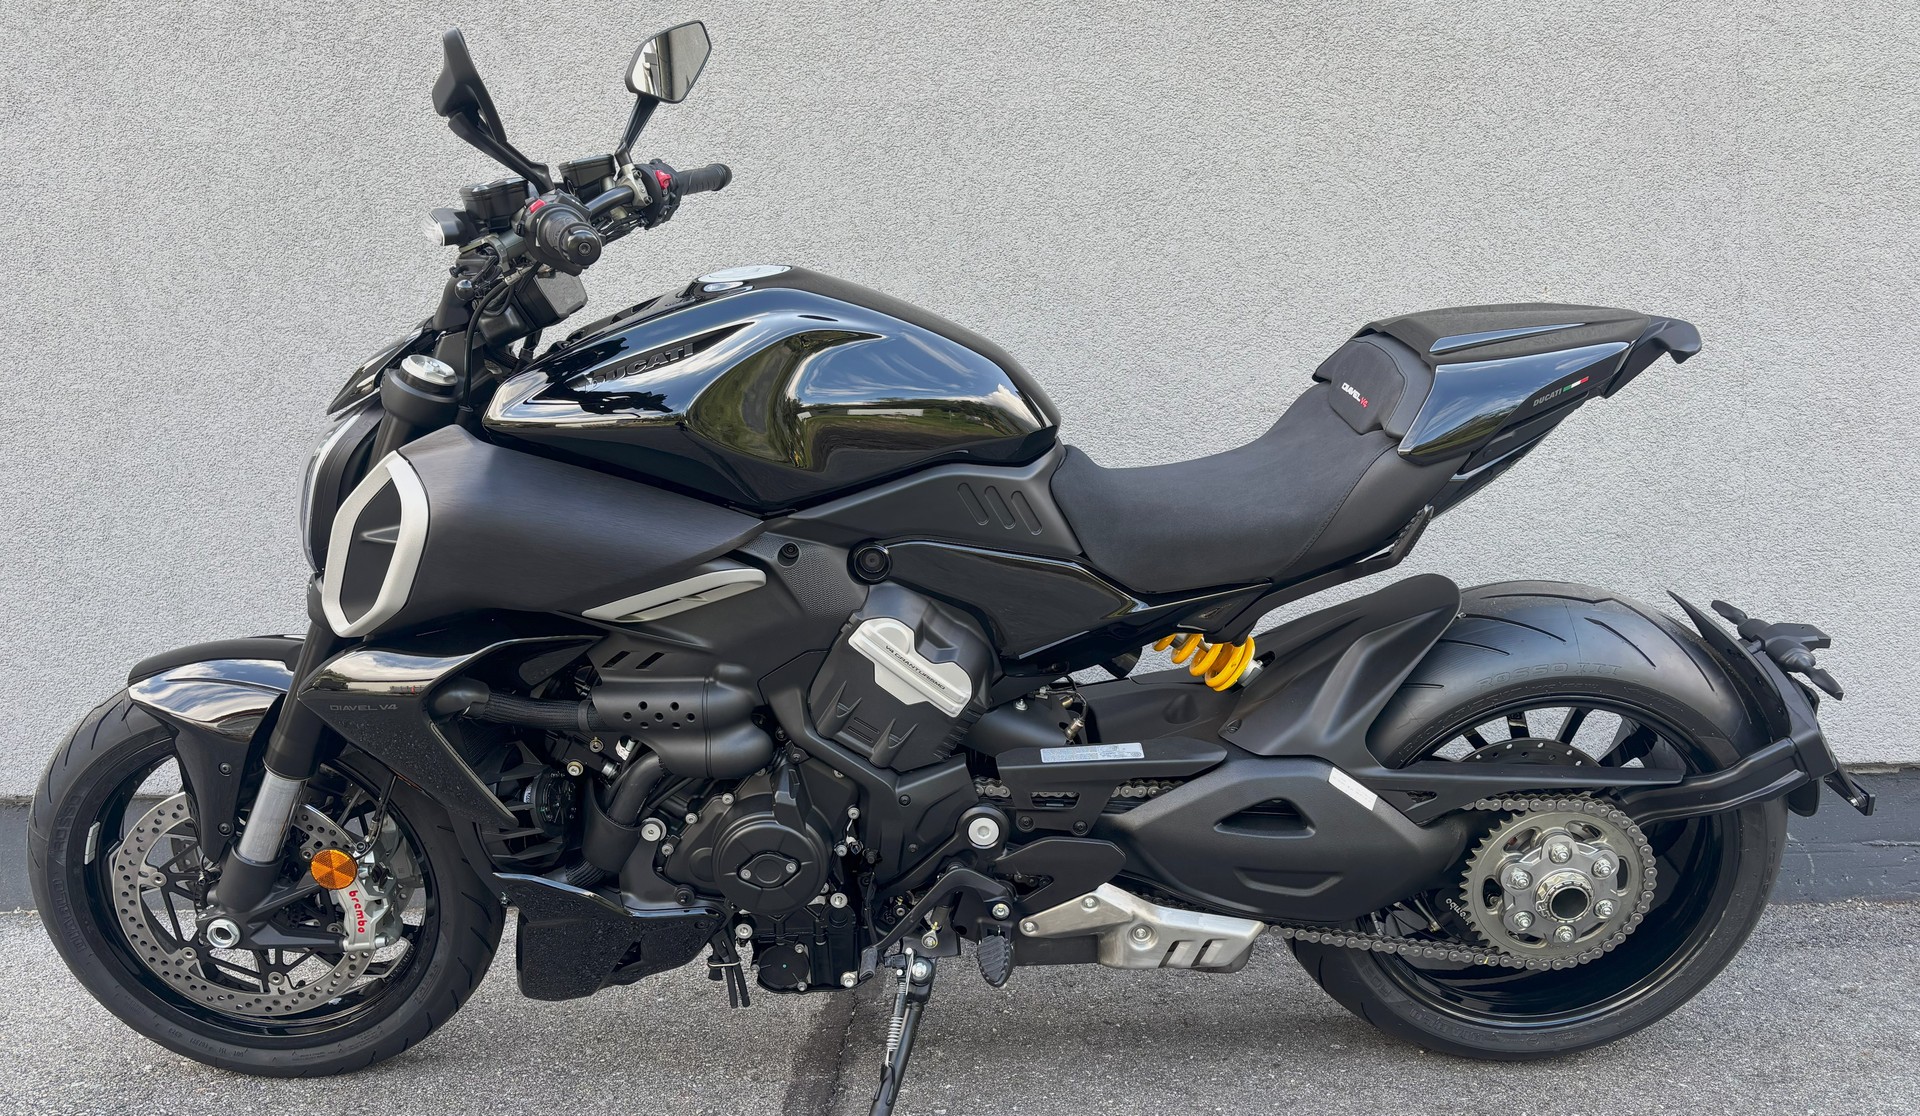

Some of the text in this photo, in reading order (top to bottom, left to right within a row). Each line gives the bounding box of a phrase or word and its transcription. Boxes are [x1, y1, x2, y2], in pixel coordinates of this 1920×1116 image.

[592, 342, 694, 386] DUCATI
[1533, 388, 1563, 407] DUCATI
[1476, 662, 1569, 691] ROSSO
[329, 703, 399, 712] DIAVEL V4
[348, 890, 368, 934] brembo
